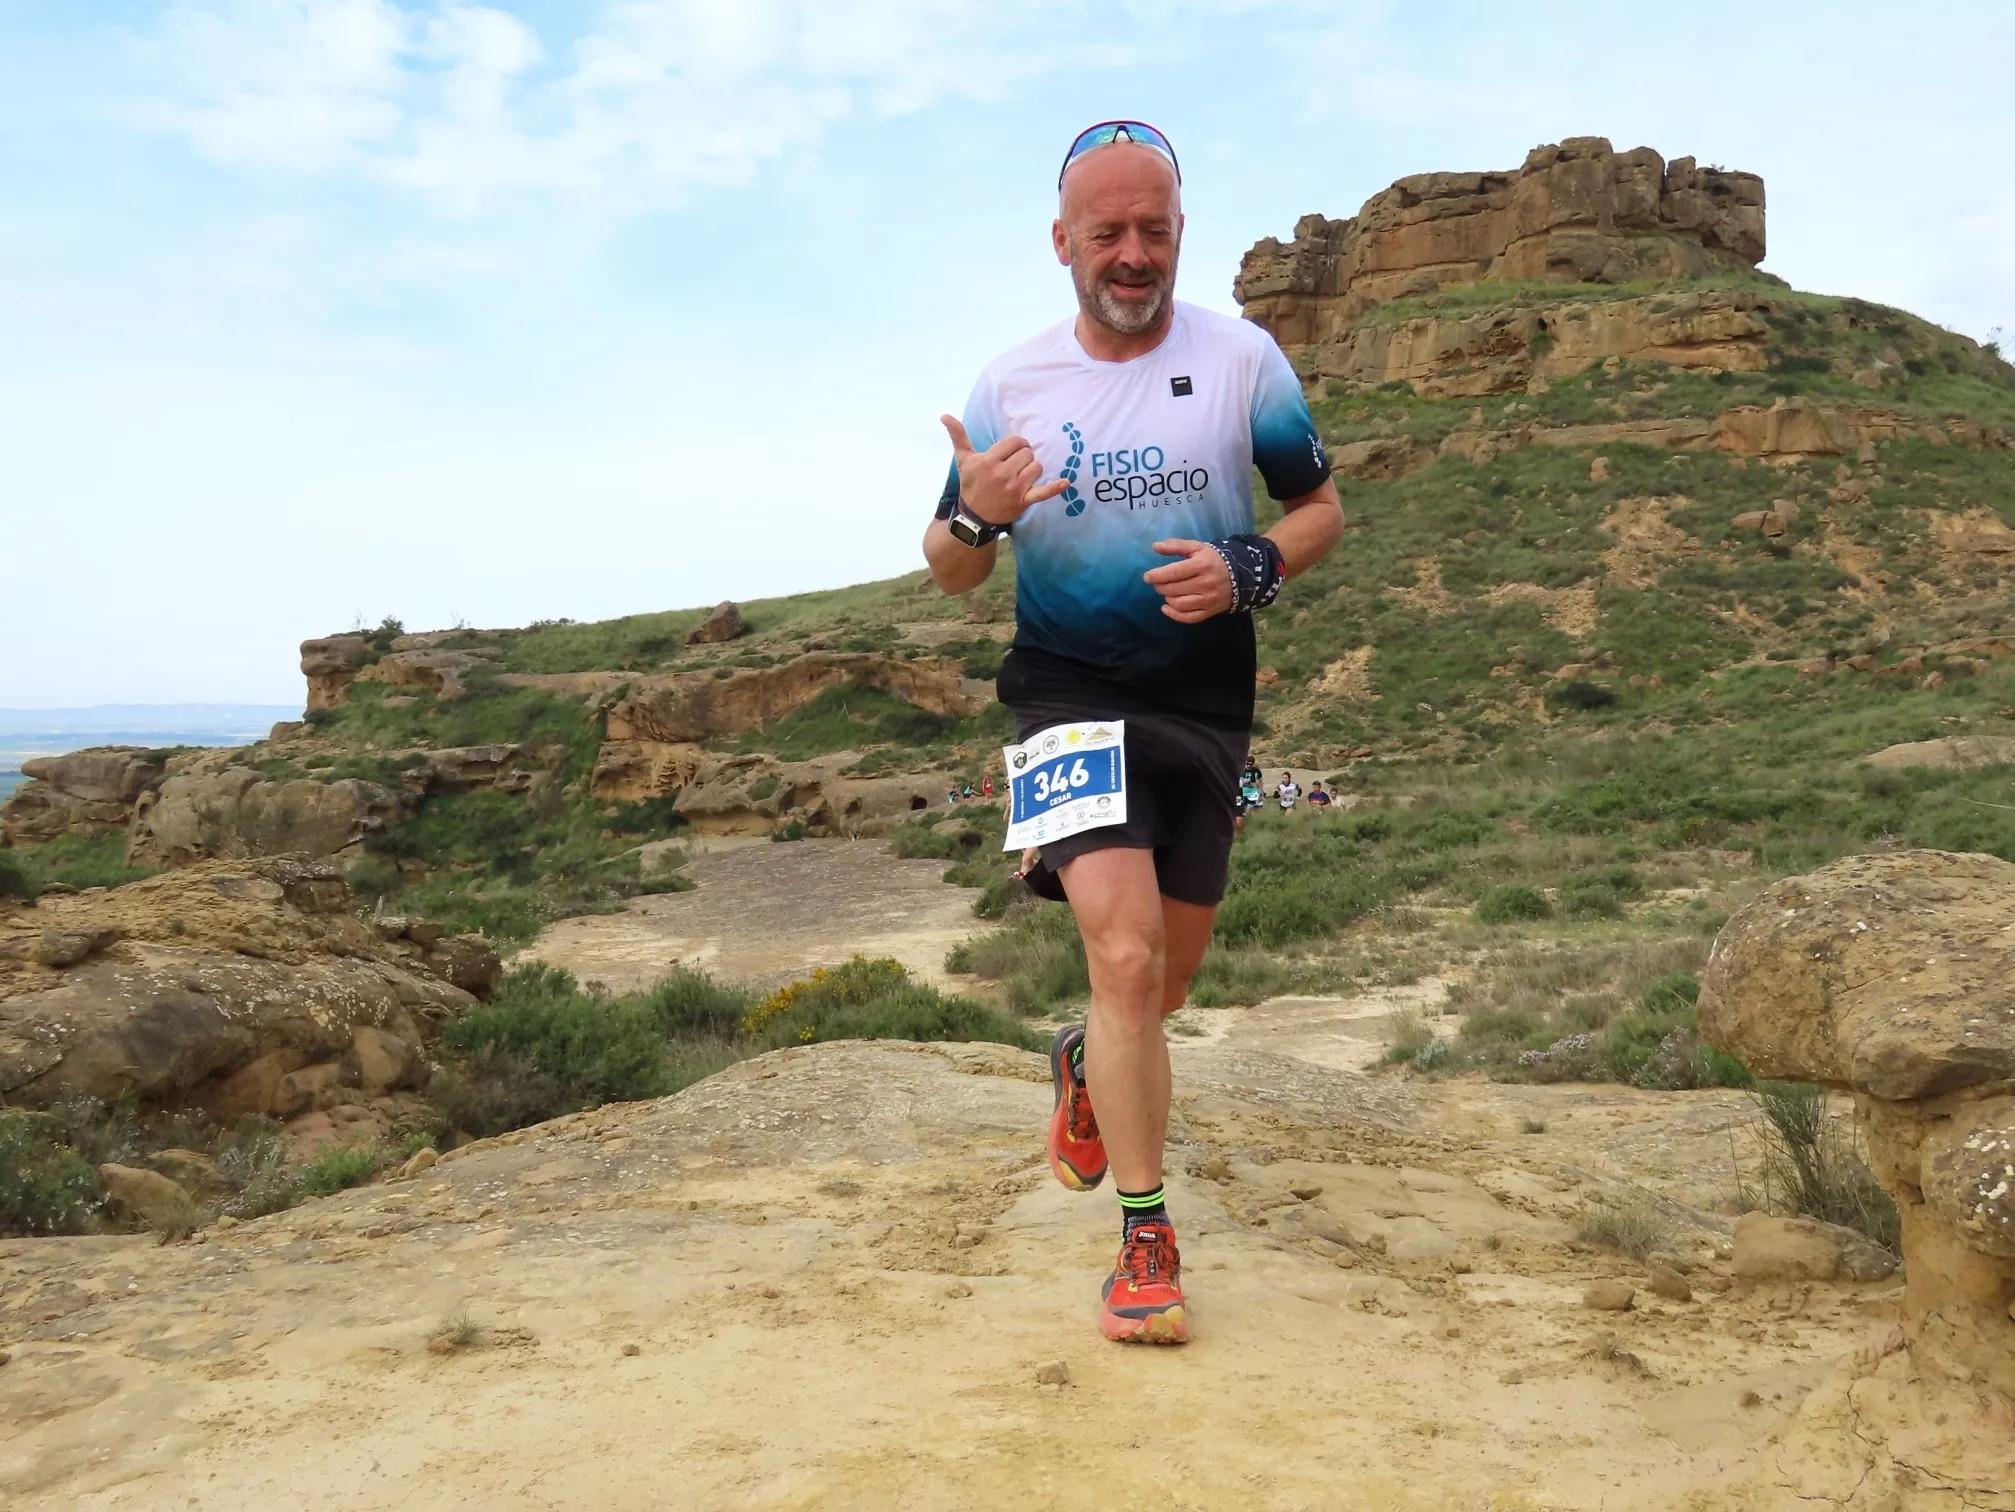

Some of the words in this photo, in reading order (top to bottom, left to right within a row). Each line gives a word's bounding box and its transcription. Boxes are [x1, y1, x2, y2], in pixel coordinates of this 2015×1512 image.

[1091, 445, 1164, 478] FISIO
[1094, 458, 1209, 511] espacio
[1138, 493, 1205, 510] HUESCA
[1034, 757, 1090, 802] 346
[1049, 792, 1072, 807] CESAR
